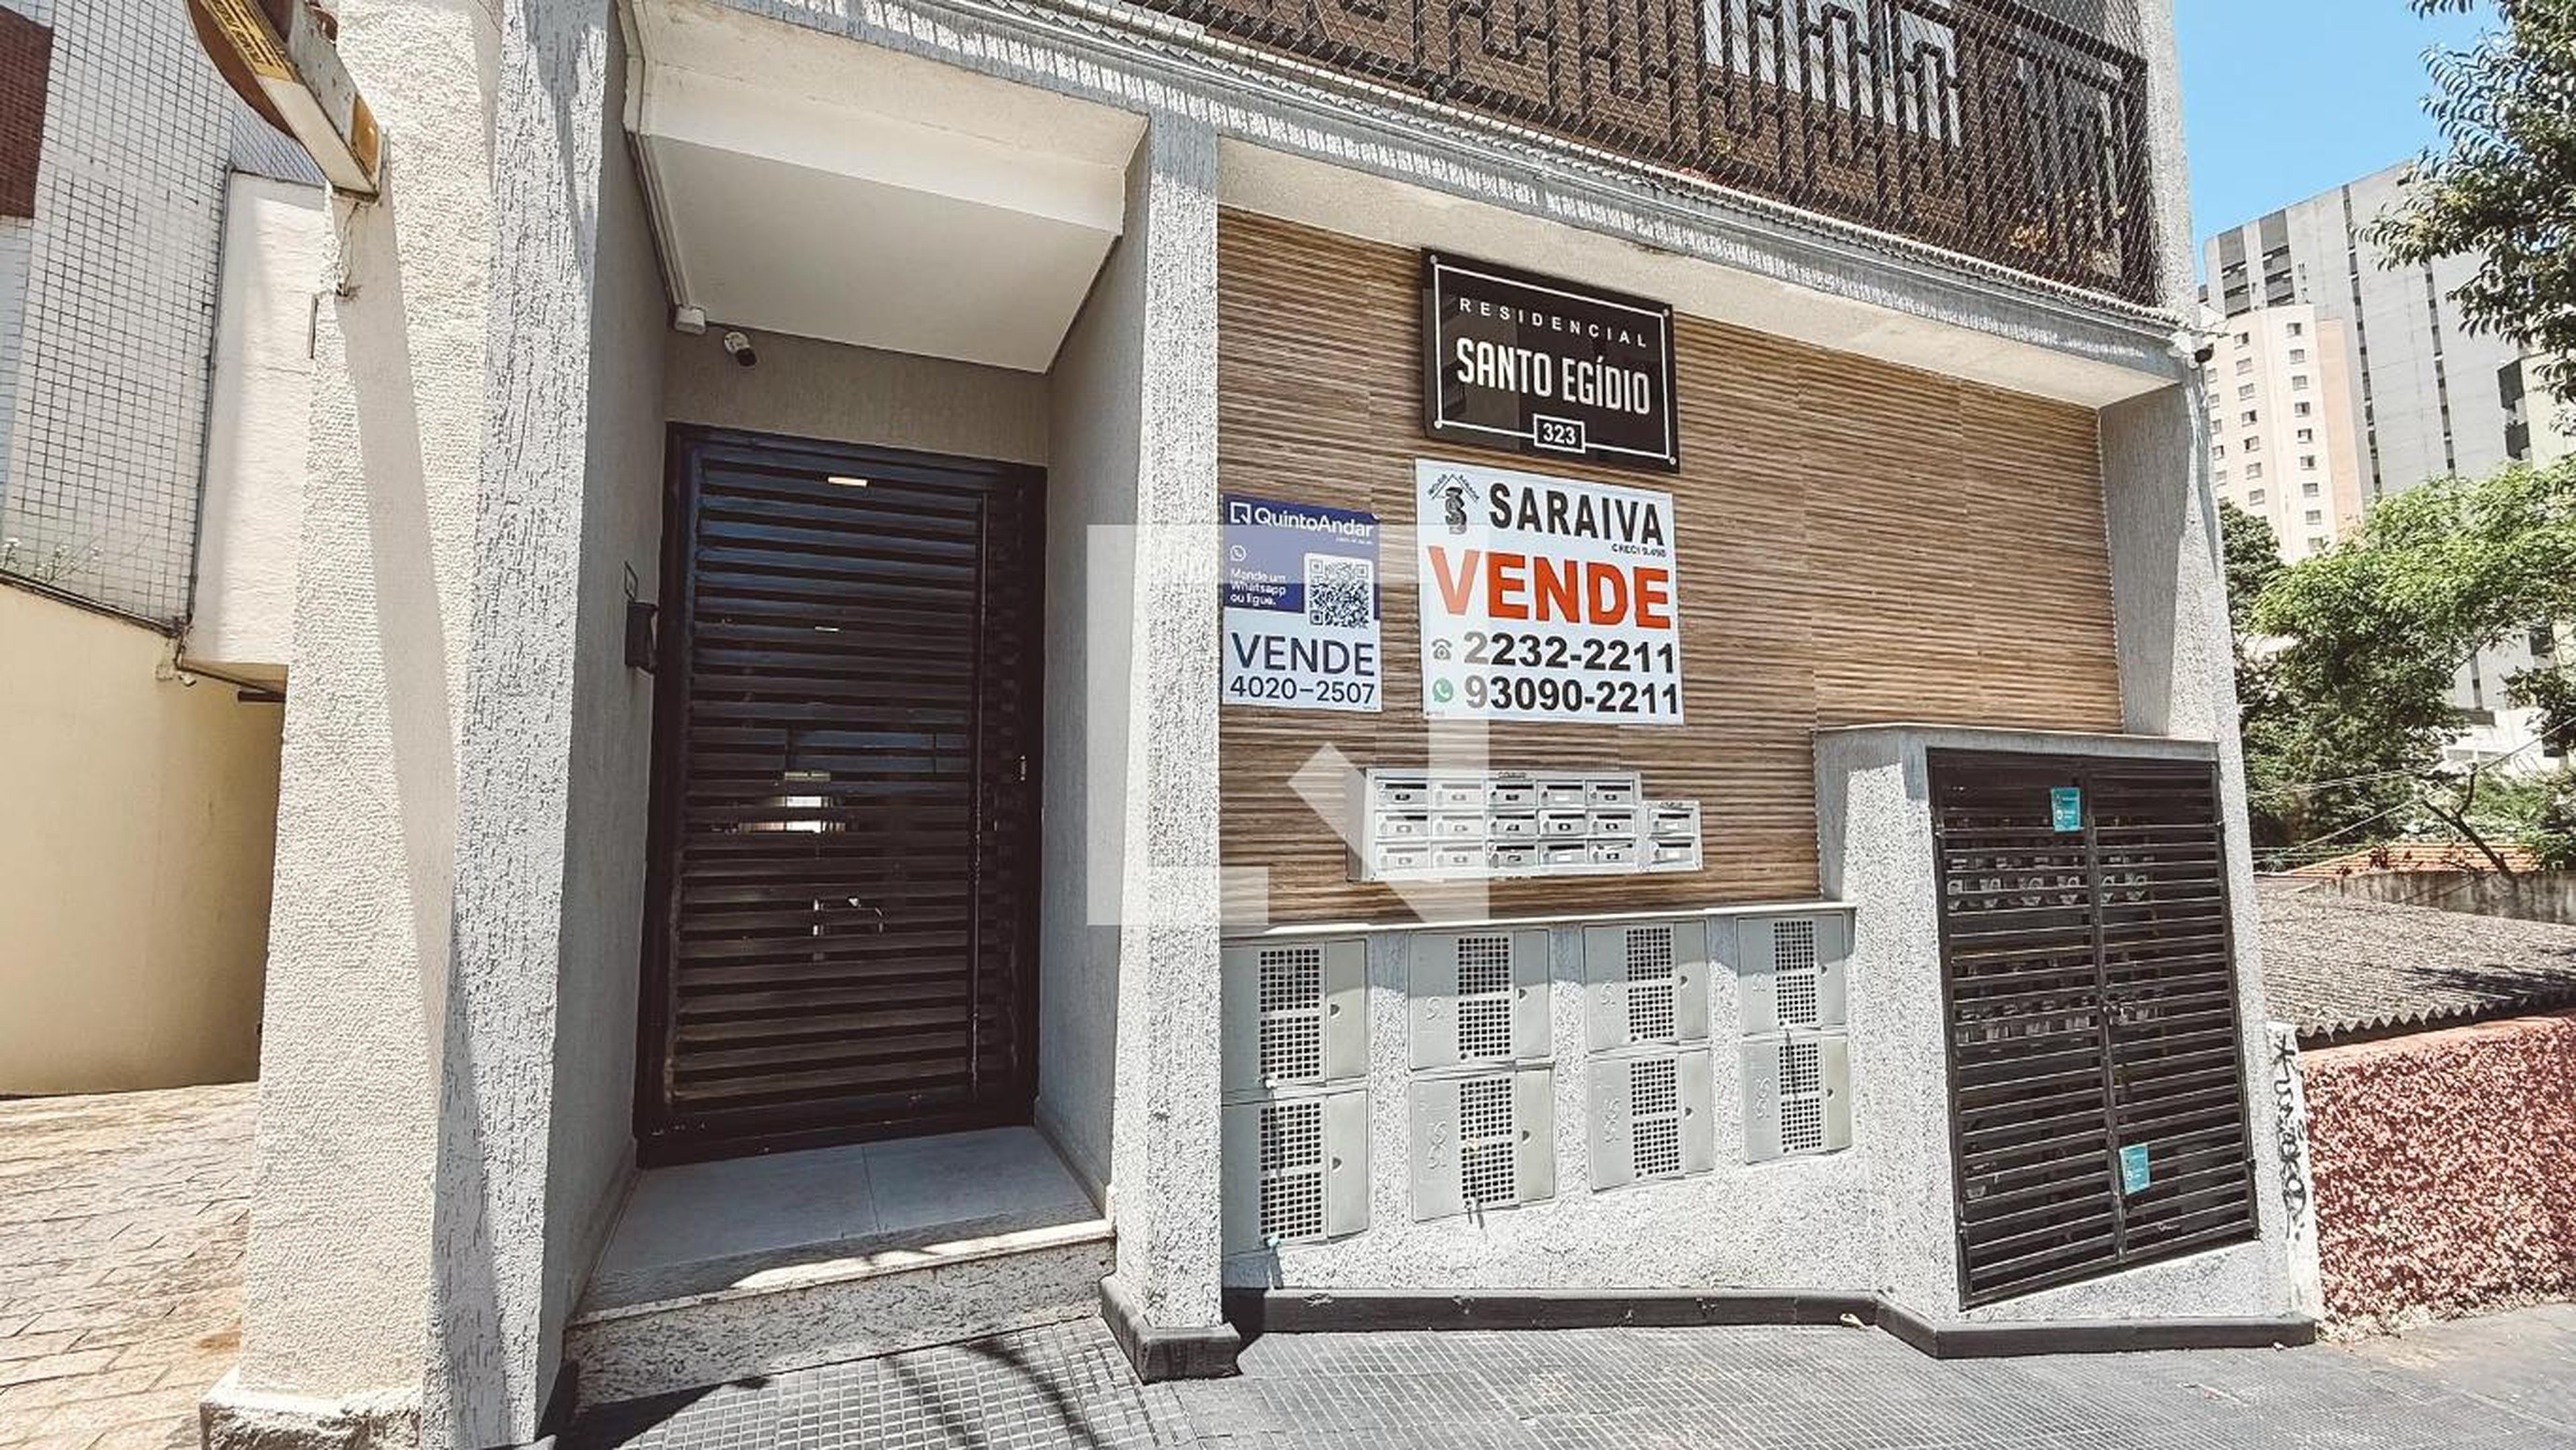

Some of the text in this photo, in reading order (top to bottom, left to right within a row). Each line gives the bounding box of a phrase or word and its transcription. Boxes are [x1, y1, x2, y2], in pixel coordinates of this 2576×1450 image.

[1460, 297, 1647, 348] RESIDENCIAL
[1456, 338, 1650, 415] SANTO EGÍDIO
[1542, 423, 1576, 445] 323
[1254, 507, 1374, 537] QuintoAndar
[1489, 482, 1664, 546] SARAIVA
[1230, 568, 1286, 582] Mande um
[1427, 546, 1671, 629] VENDE
[1230, 594, 1244, 603] ou
[1231, 632, 1375, 676] VENDE
[1463, 631, 1674, 674] 2232-2211
[1230, 676, 1375, 704] 4020-2507
[1464, 675, 1678, 714] 93090-2211
